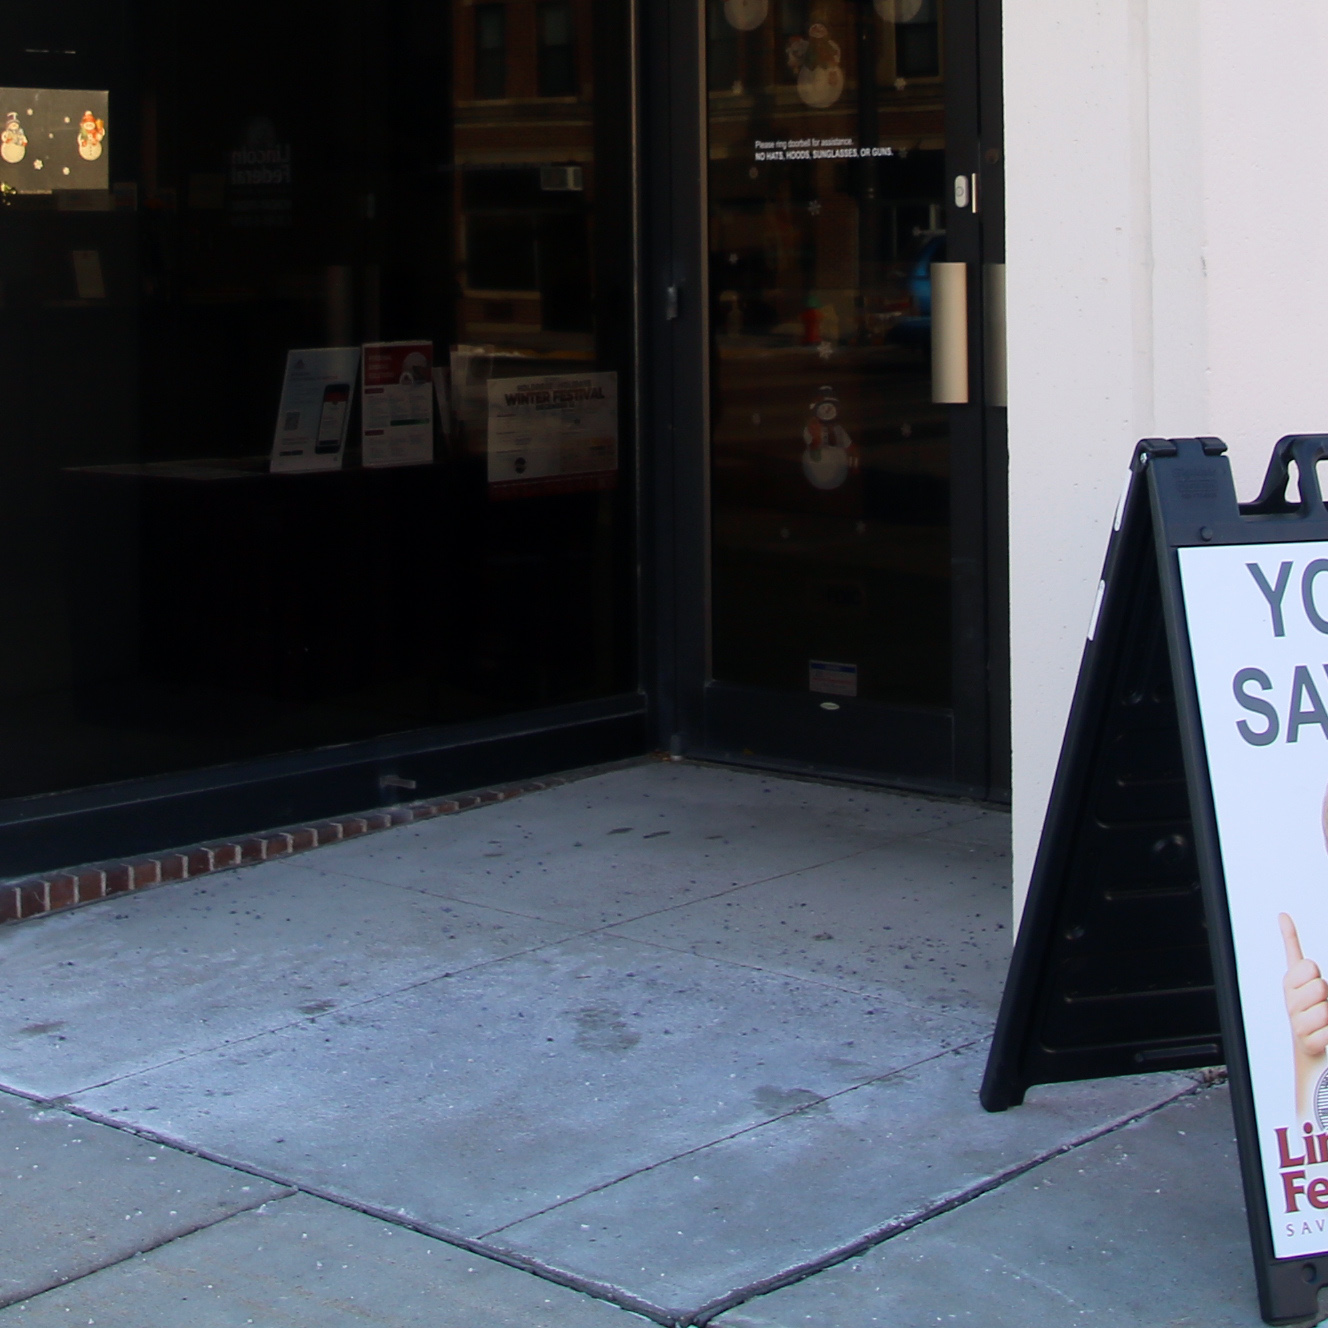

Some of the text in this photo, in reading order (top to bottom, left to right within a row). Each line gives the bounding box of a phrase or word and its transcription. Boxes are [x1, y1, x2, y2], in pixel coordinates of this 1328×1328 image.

[755, 138, 853, 150] Please ring doorbell for assistance.
[755, 152, 765, 161] NO
[766, 151, 785, 160] HATS,
[786, 150, 810, 160] HOODS,
[860, 147, 871, 157] OR
[872, 147, 893, 156] GUNS.
[504, 386, 605, 406] WINTER FESTIVAL
